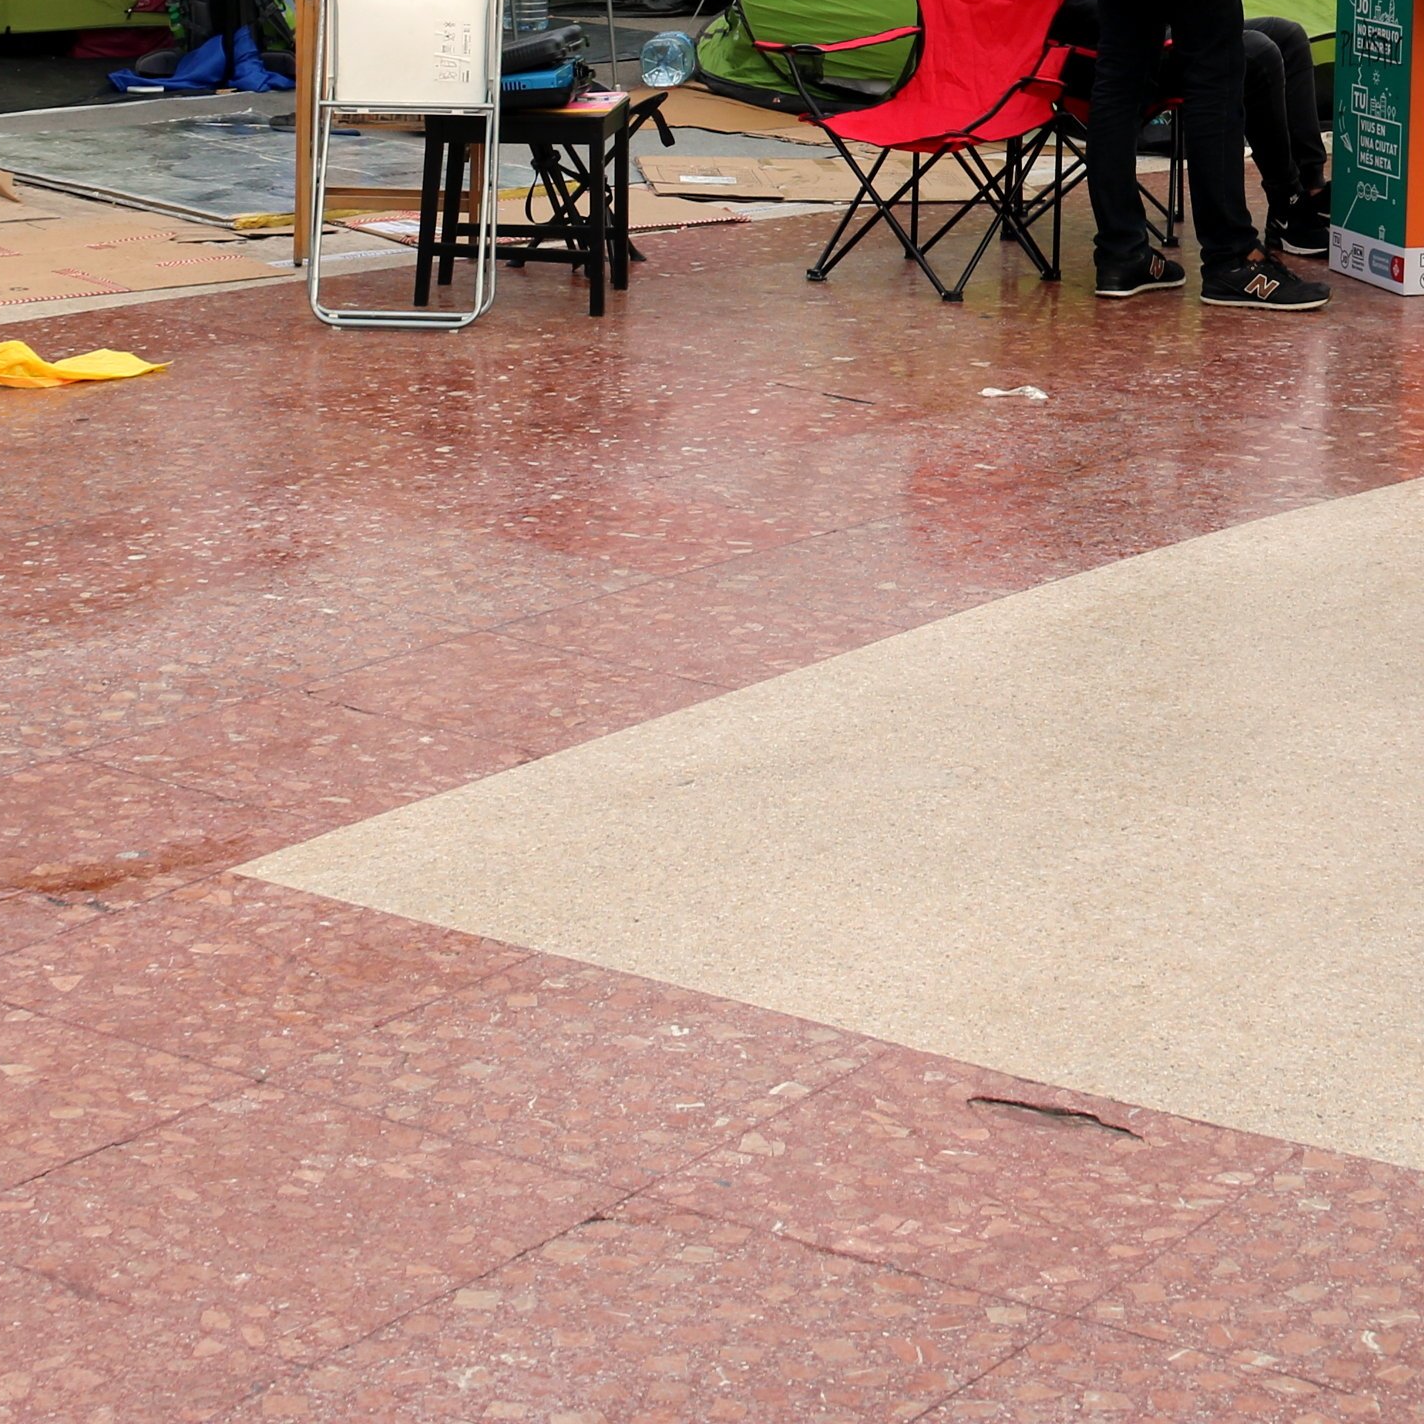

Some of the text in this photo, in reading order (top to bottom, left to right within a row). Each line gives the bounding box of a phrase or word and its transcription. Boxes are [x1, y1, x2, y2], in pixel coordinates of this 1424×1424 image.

[1357, 23, 1367, 36] NO
[1353, 91, 1367, 109] TU
[1360, 119, 1386, 137] VIUS EN
[1360, 135, 1398, 156] UNA CIUTAT
[1359, 149, 1392, 171] MÉS NETA
